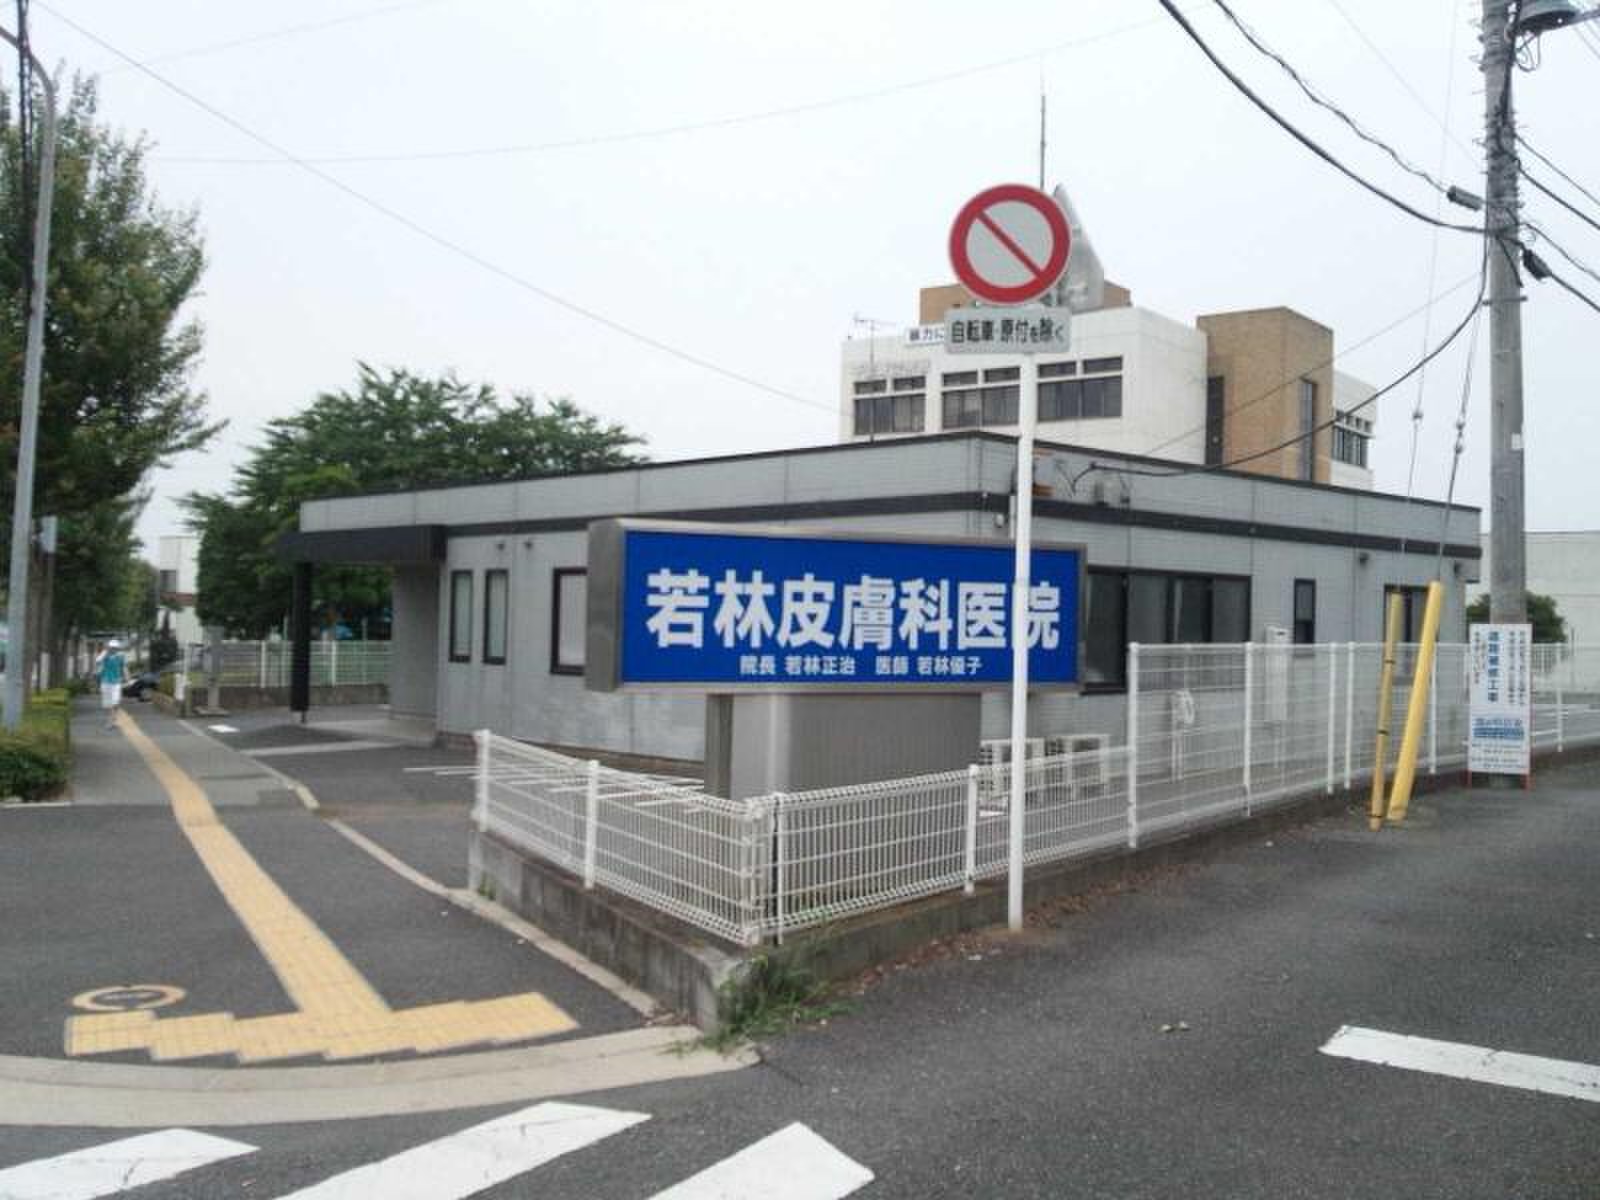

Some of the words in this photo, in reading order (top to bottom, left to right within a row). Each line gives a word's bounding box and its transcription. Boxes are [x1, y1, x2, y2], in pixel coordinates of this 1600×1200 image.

[645, 568, 1061, 651] 若林皮膚科医院
[739, 655, 776, 676] 院長
[784, 655, 856, 676] 若林正治
